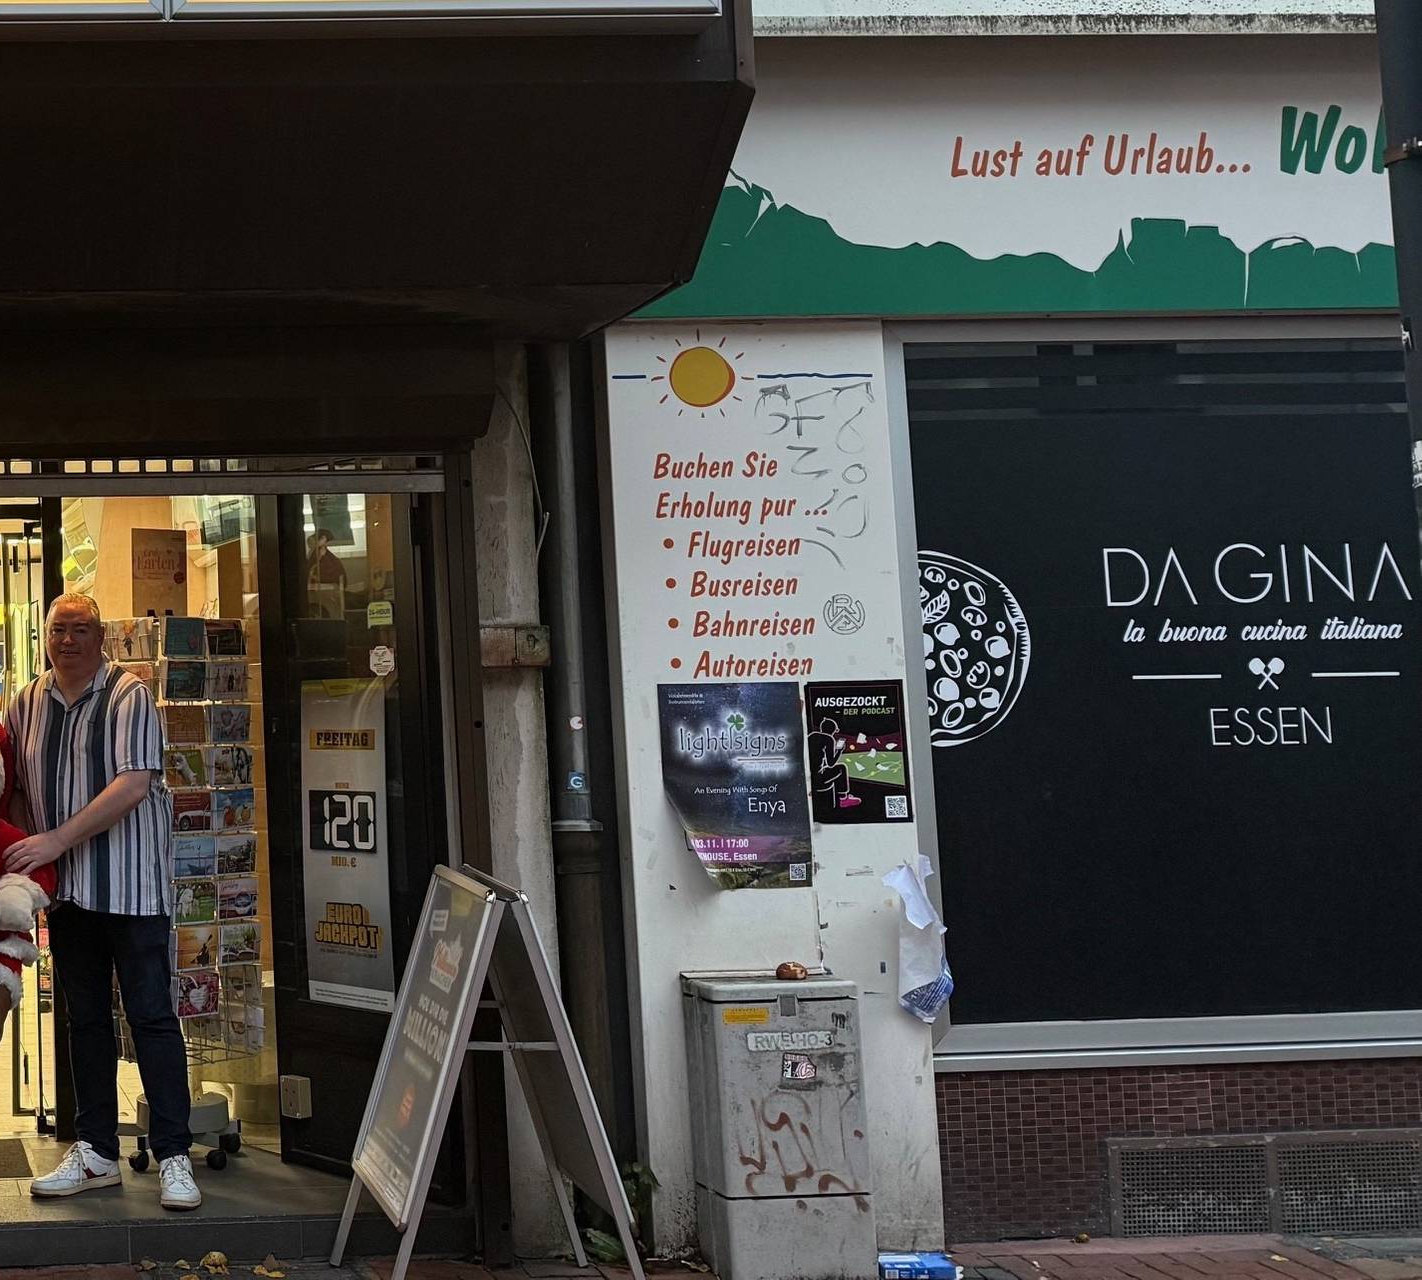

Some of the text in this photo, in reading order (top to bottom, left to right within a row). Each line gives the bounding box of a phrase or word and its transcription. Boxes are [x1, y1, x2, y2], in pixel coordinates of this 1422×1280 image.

[951, 132, 1251, 178] Lust auf Urlaub...
[653, 451, 778, 479] Buchen Sie
[656, 491, 752, 525] Erholung
[760, 497, 797, 525] pur
[688, 530, 801, 565] Flugreisen
[690, 570, 798, 597] Busreisen
[1103, 542, 1413, 606] DA GINA
[692, 610, 815, 637] Bahnreisen
[1123, 617, 1403, 642] la buona cucina italiana
[693, 650, 813, 678] Autoreisen
[815, 696, 887, 707] AUSGEZOCKT
[861, 707, 895, 715] PODCAST
[1210, 706, 1333, 745] ESSEN
[316, 732, 369, 747] FREITAG
[706, 786, 731, 795] Evening
[749, 786, 767, 795] Songs
[768, 784, 778, 793] Of
[748, 797, 786, 817] Enya
[323, 794, 375, 849] 120
[727, 839, 749, 848] 17:00
[733, 853, 758, 861] Essen
[326, 902, 364, 925] EURO
